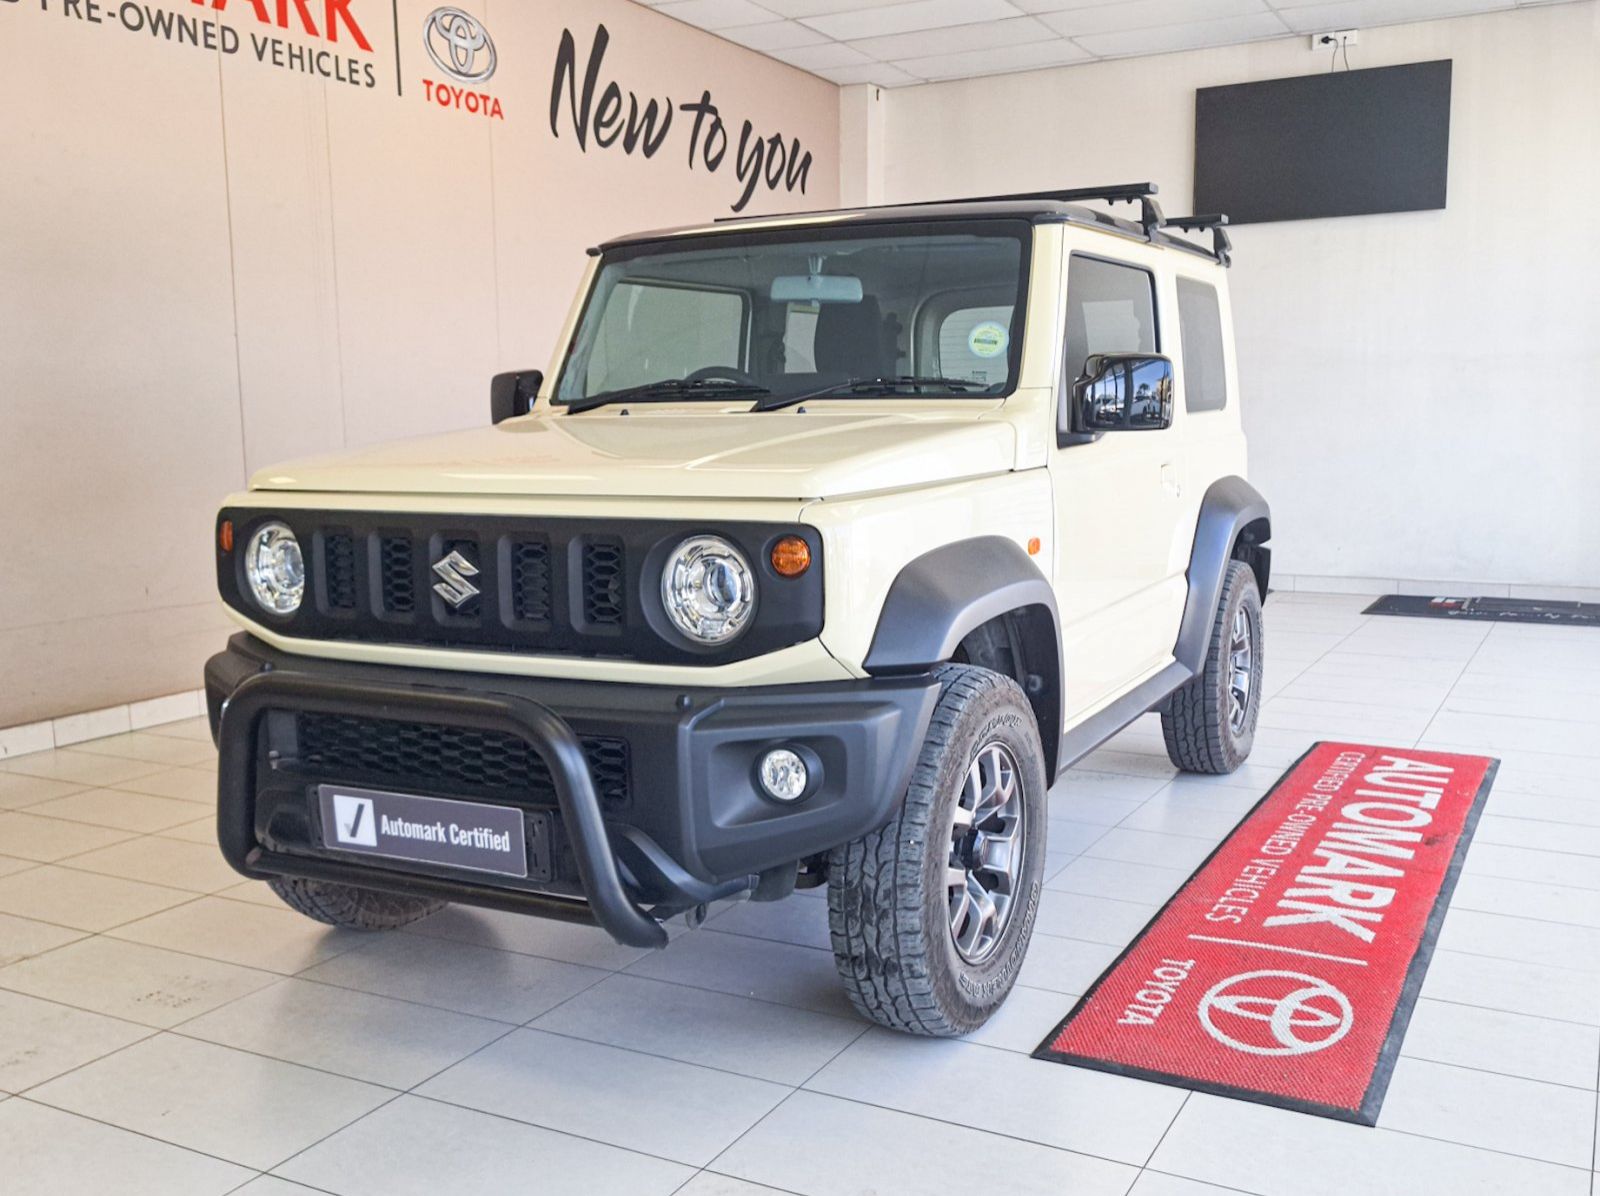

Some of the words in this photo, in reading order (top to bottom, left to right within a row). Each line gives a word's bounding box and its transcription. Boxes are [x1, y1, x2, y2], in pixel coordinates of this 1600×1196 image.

[250, 32, 376, 89] VEHICLES
[422, 78, 504, 120] TOYOTA
[549, 23, 674, 160] New
[679, 90, 728, 173] to
[730, 119, 813, 213] you
[1312, 750, 1367, 793] CERTIFIED
[381, 814, 447, 844] Automark
[449, 822, 511, 853] Certified
[1260, 791, 1333, 856] PRE-OWNED
[1262, 755, 1455, 944] AUTOMARK
[1205, 857, 1280, 925] VEHICLES
[1117, 958, 1195, 1026] TOYOTA
